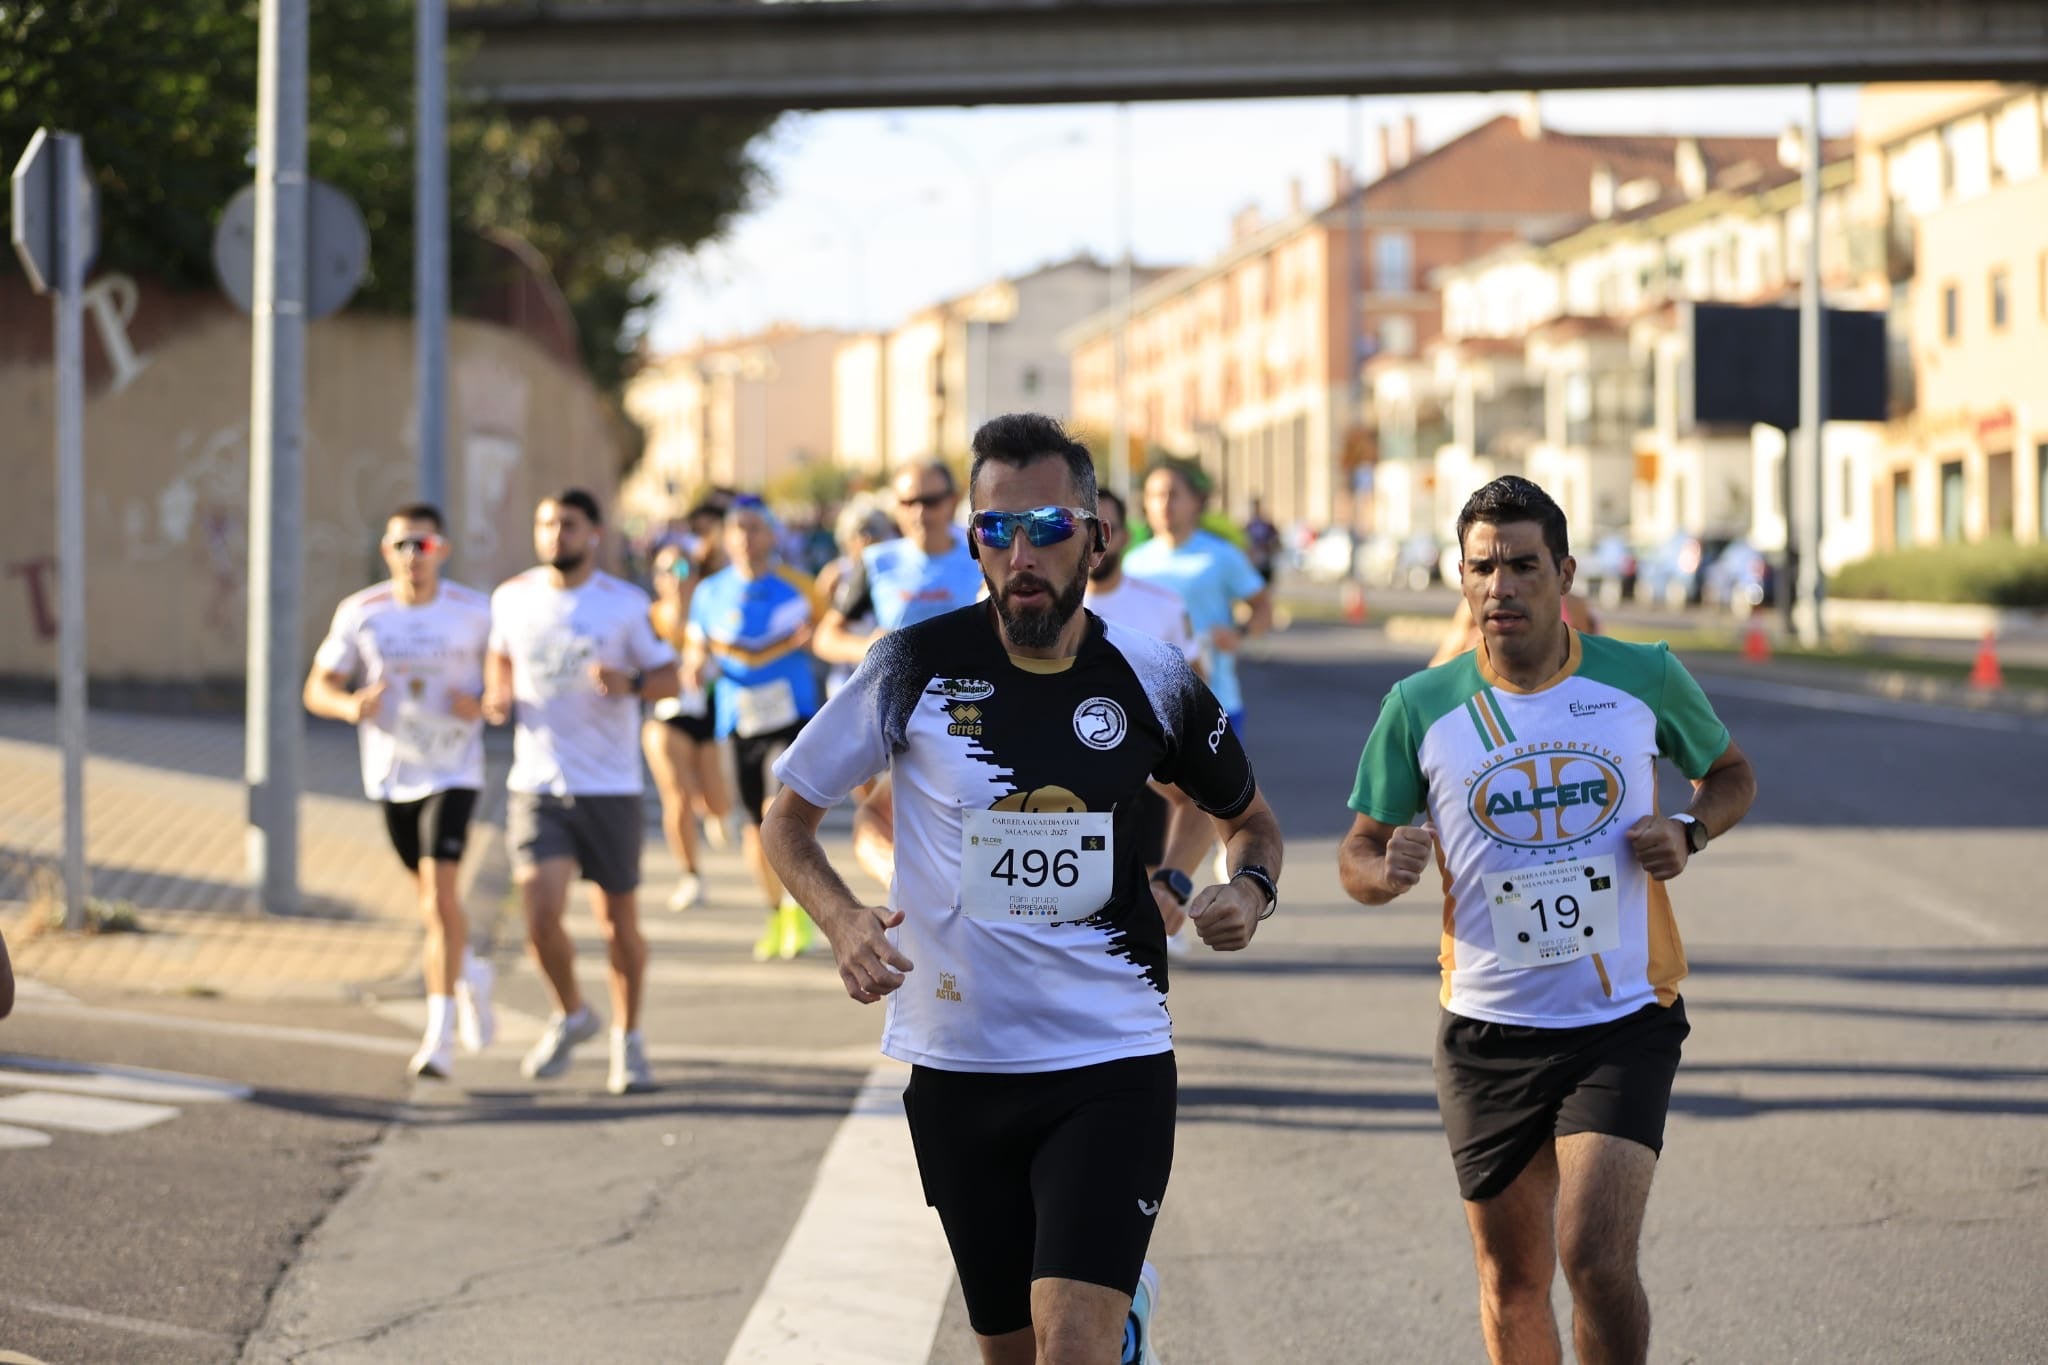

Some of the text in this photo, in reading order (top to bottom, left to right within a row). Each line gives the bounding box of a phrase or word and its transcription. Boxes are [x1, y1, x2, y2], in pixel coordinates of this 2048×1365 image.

[1464, 740, 1622, 787] CLUB DEPORTIVO
[1485, 779, 1610, 817] ALCER
[992, 817, 1026, 826] CARRERA
[1061, 818, 1080, 827] CIVIL
[1004, 828, 1068, 837] SALAMANCA 2025
[1483, 816, 1620, 857] SALAMANCA
[990, 848, 1079, 888] 496
[1009, 903, 1058, 912] EMPRESARIAL
[1530, 894, 1580, 932] 19
